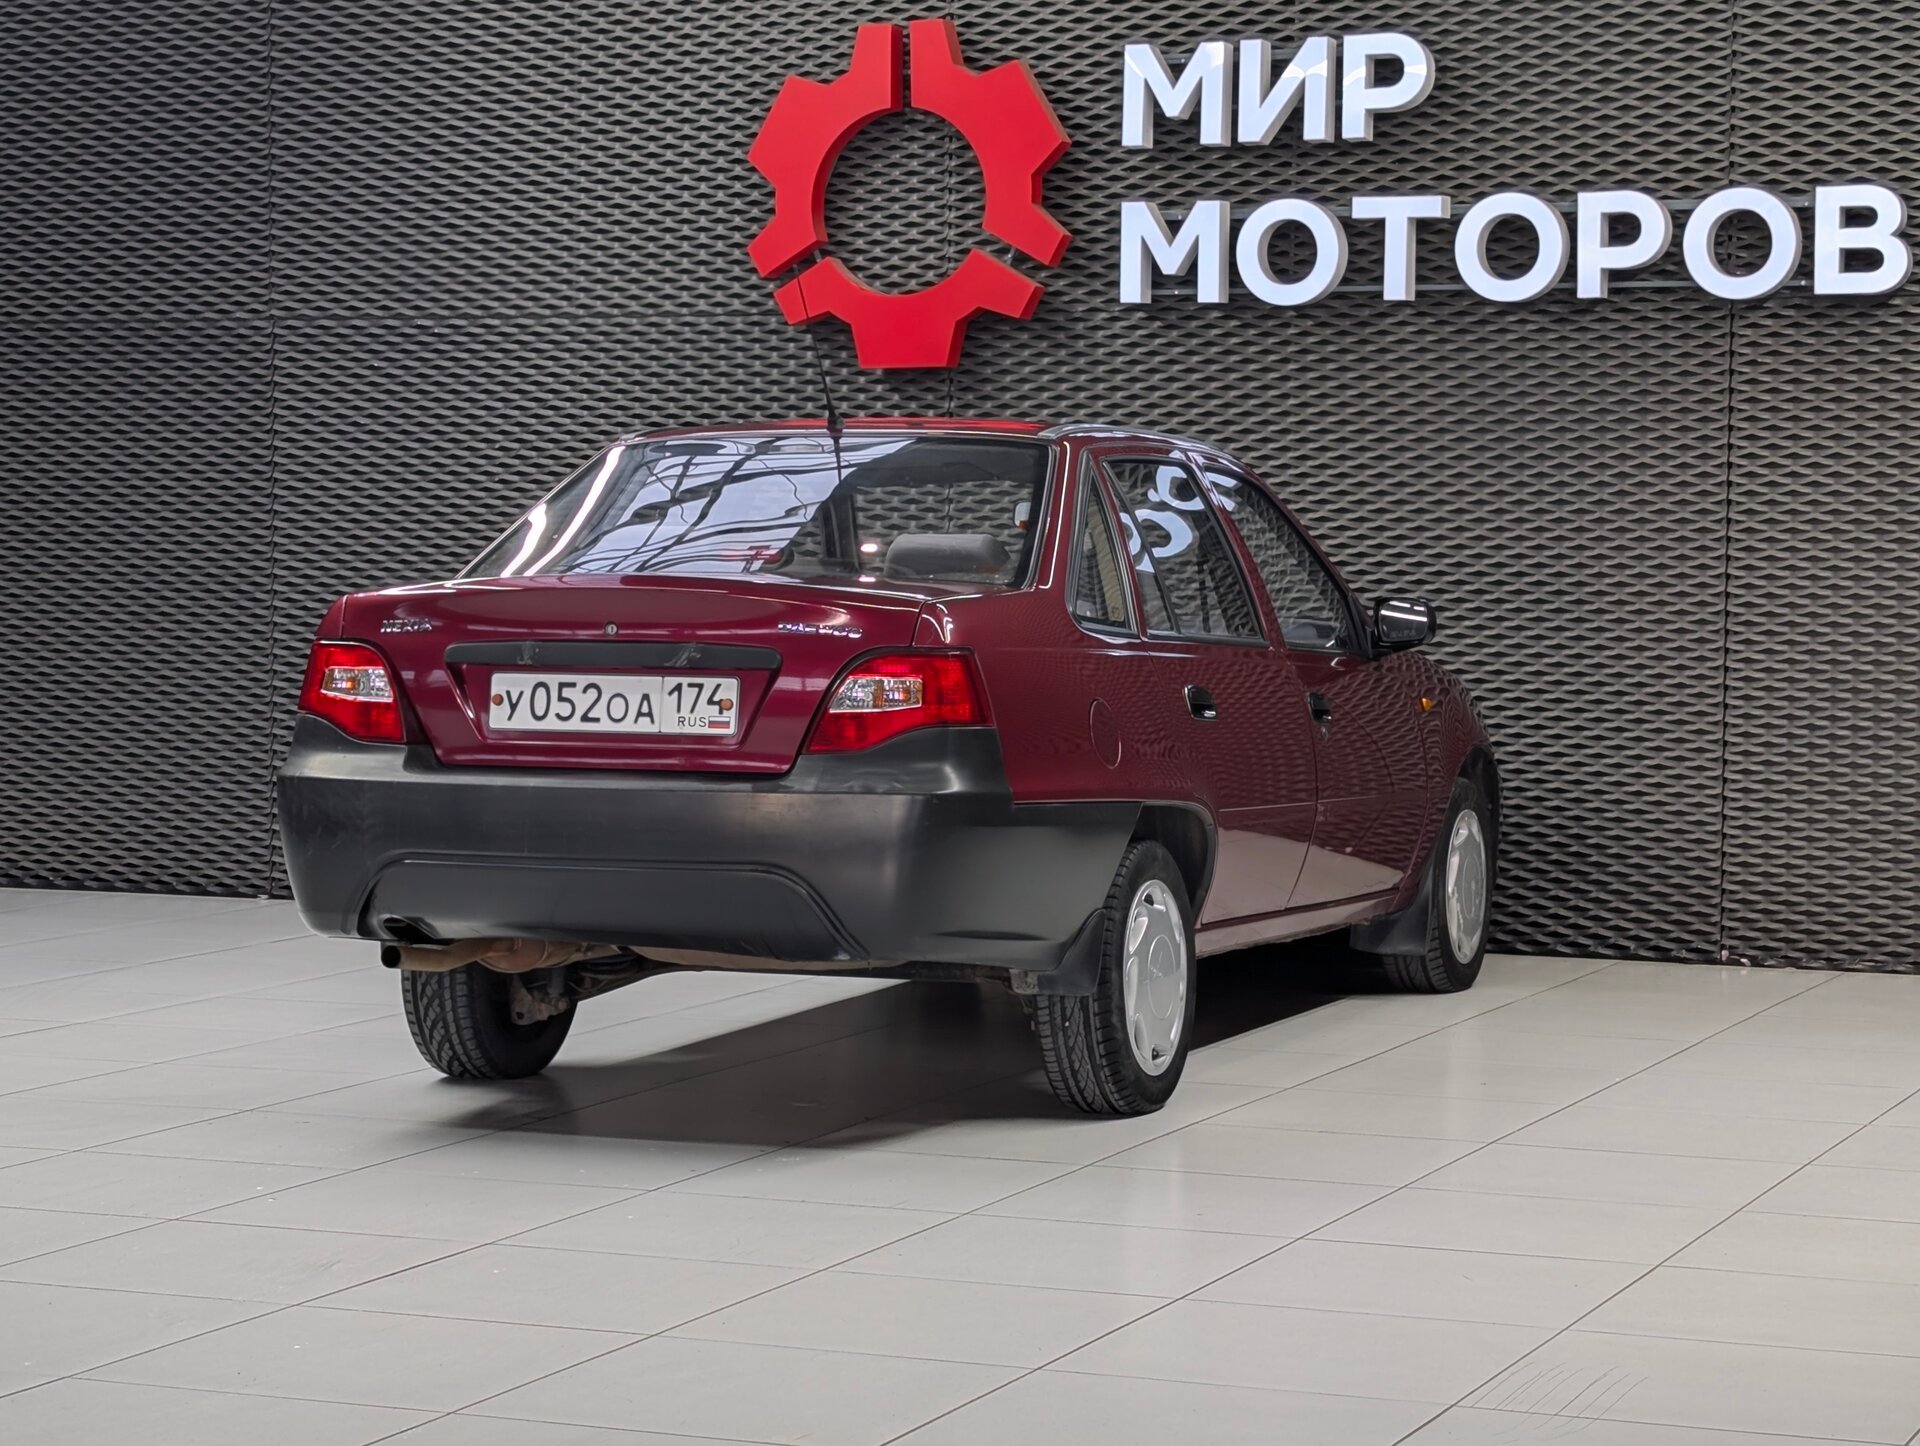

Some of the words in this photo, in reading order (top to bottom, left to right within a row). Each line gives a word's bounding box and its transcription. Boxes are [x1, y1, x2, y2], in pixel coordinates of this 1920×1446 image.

[1121, 33, 1436, 148] МИР
[1119, 185, 1912, 306] МОТОРОВ
[667, 682, 730, 715] 174
[677, 716, 707, 728] RUS
